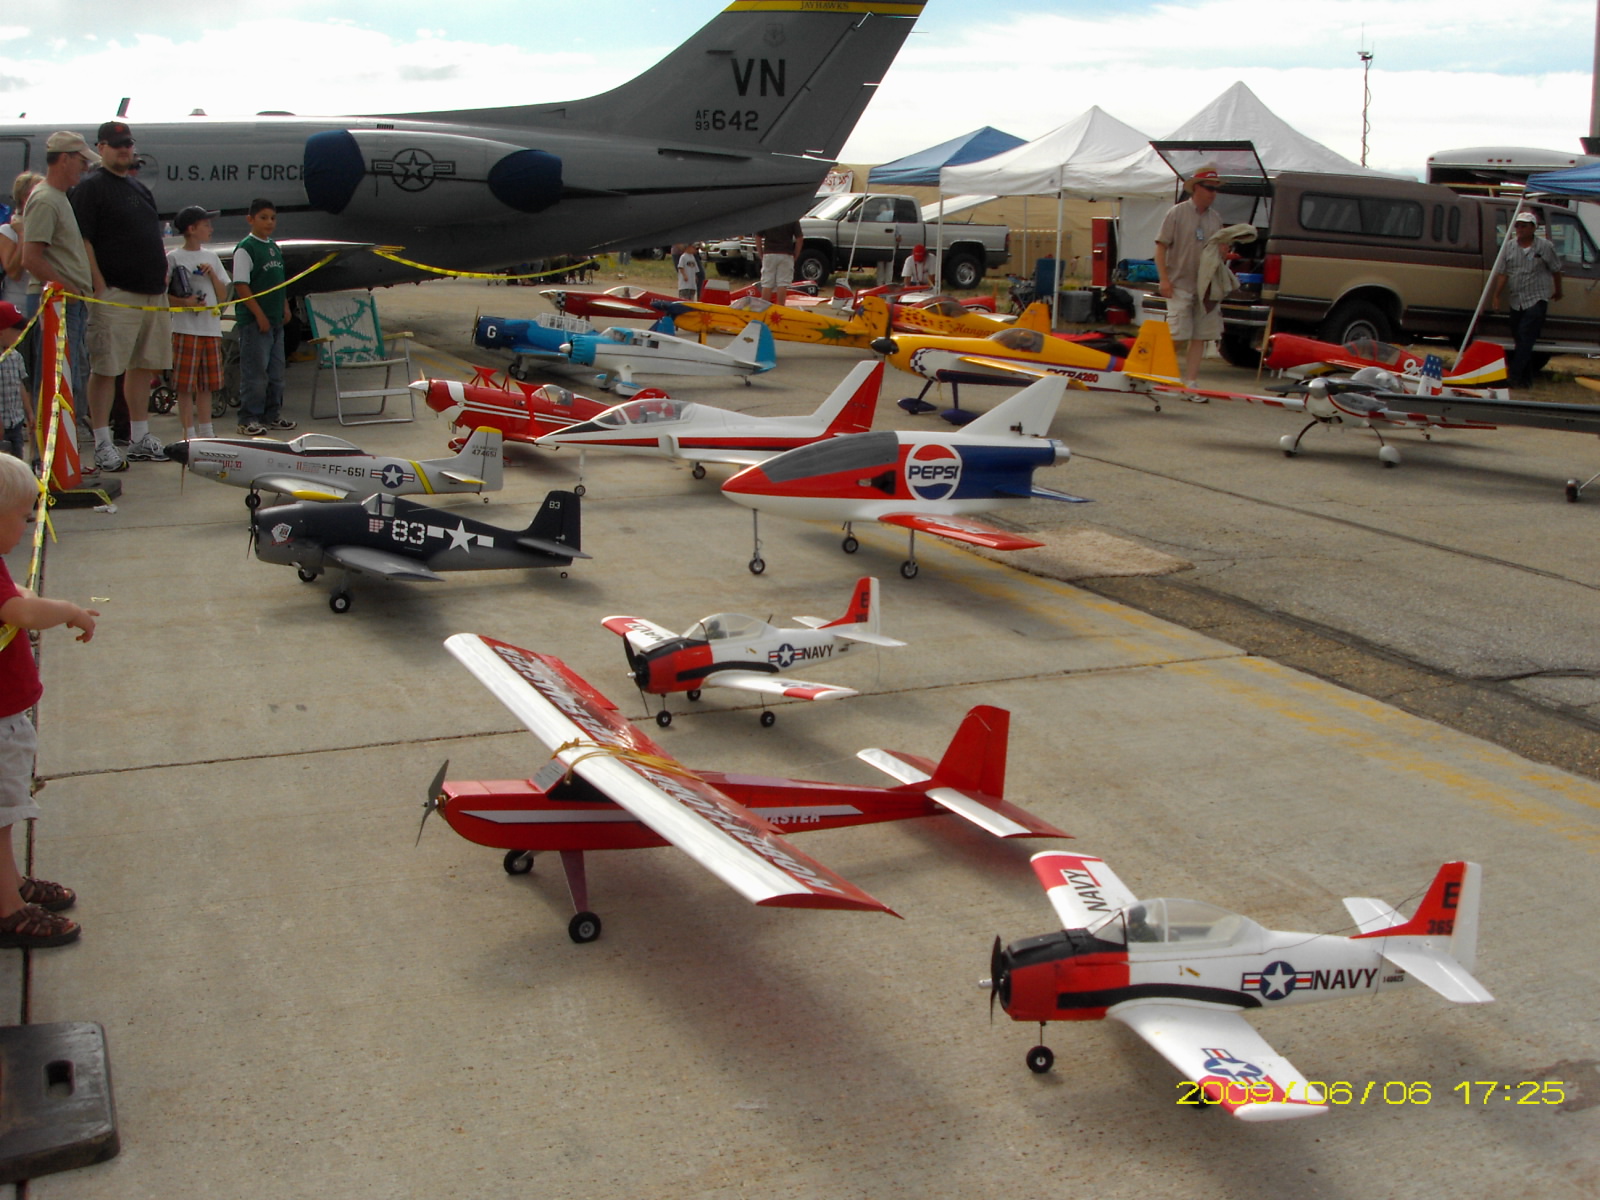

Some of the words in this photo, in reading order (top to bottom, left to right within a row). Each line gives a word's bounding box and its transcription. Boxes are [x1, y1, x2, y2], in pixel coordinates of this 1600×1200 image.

[800, 1, 849, 10] JAYHAWKS
[731, 58, 786, 97] VN
[695, 111, 710, 120] AF
[711, 110, 759, 131] 642
[695, 121, 710, 131] 93
[167, 165, 205, 181] U.S.
[210, 165, 239, 181] AIR
[486, 325, 497, 339] G
[328, 464, 365, 478] FF-651
[908, 465, 960, 480] PEPSI
[391, 519, 426, 545] 83
[803, 644, 834, 660] NAVY
[764, 812, 820, 826] ASTER
[1063, 869, 1113, 913] NAVY
[1442, 882, 1462, 910] E
[1313, 967, 1379, 991] NAVY
